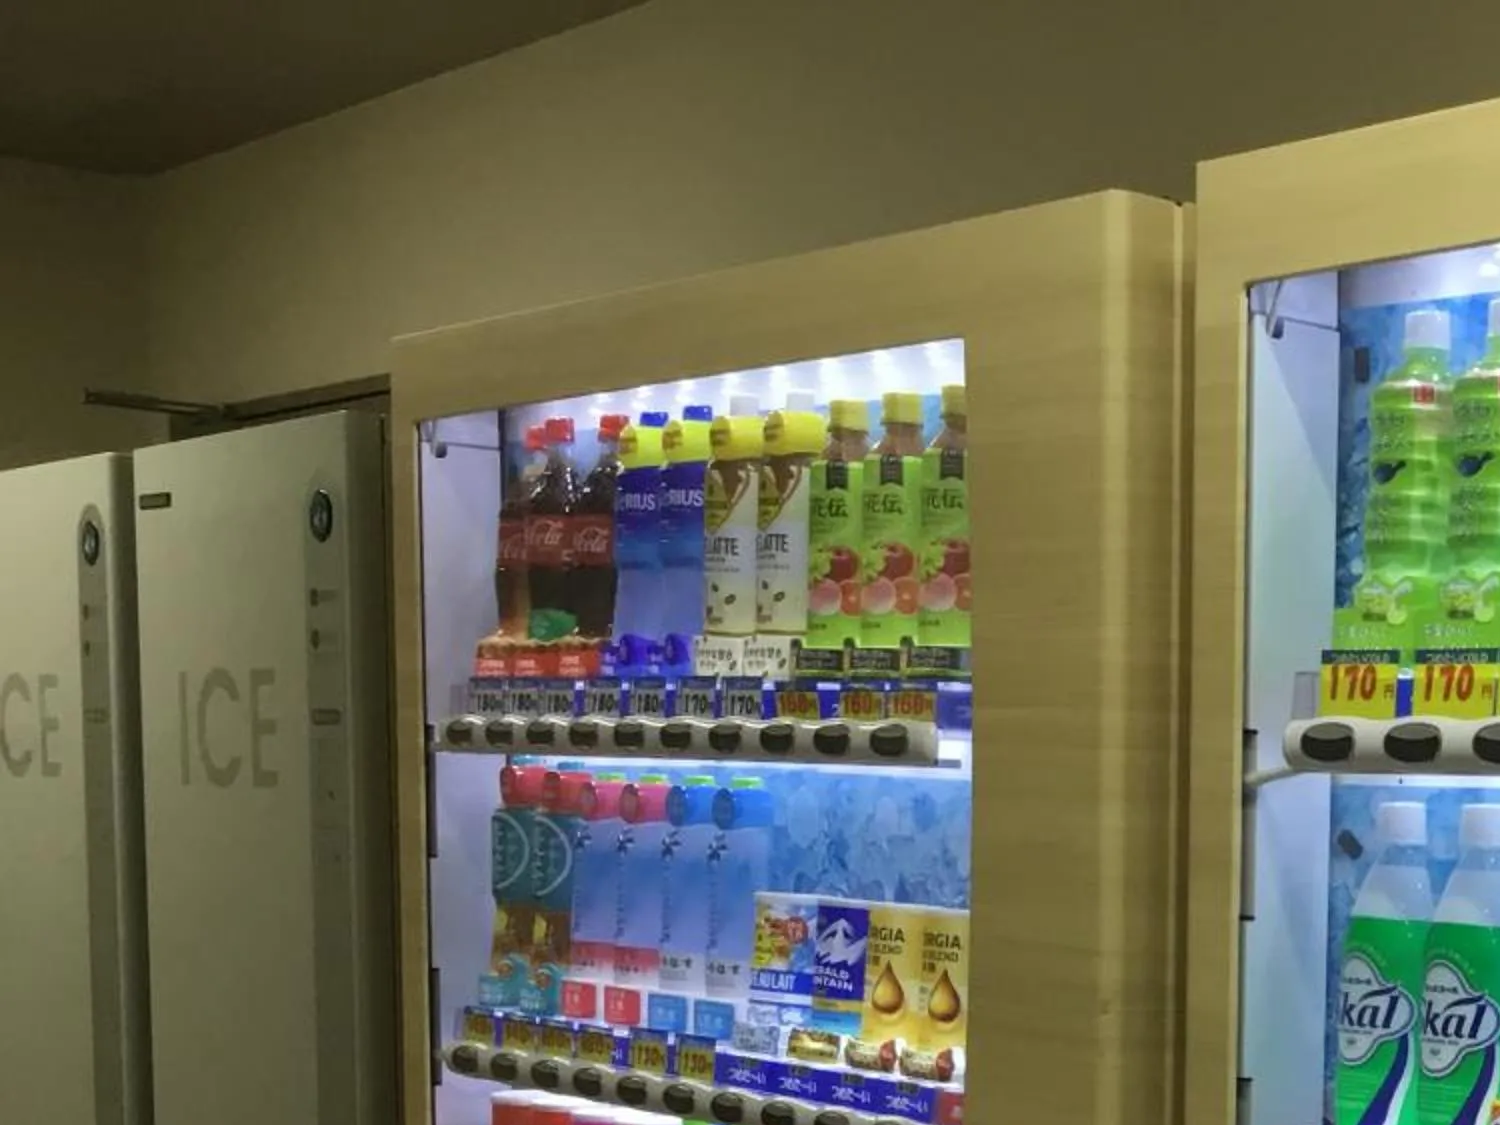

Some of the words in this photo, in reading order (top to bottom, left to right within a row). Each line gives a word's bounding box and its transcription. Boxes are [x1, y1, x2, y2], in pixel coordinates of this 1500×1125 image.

[1330, 664, 1393, 701] 170円
[1424, 664, 1491, 701] 170円
[178, 667, 279, 788] ICE
